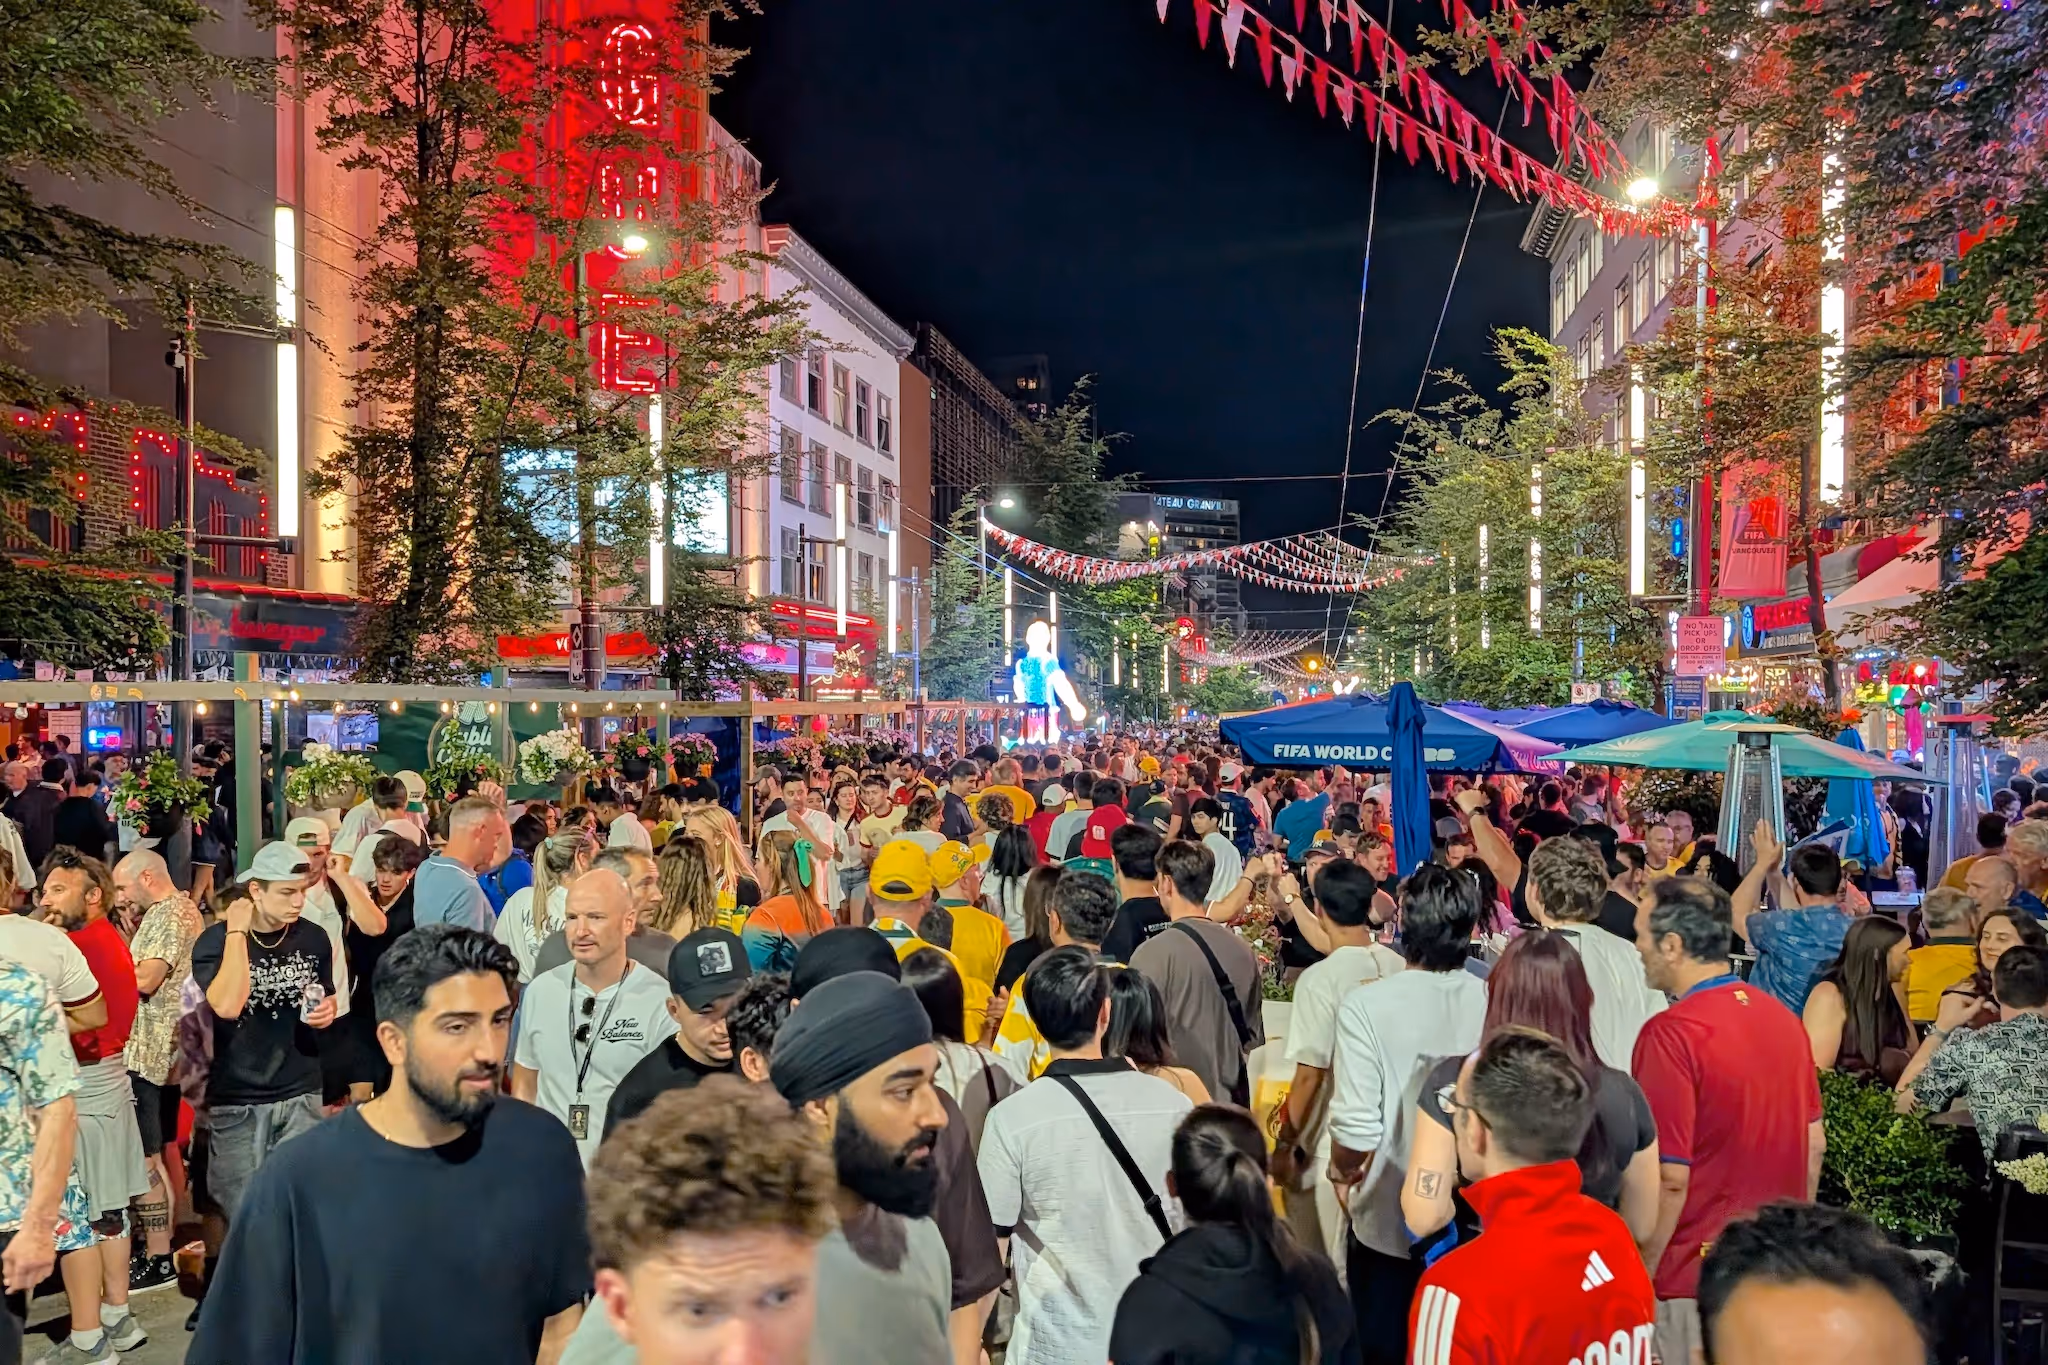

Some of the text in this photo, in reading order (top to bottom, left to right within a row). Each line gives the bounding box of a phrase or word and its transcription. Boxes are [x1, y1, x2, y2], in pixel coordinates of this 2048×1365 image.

[1744, 531, 1765, 539] FIFA
[1273, 744, 1310, 758] FIFA
[1314, 745, 1379, 760] WORLD
[613, 1017, 639, 1029] New
[600, 1028, 644, 1041] Balance
